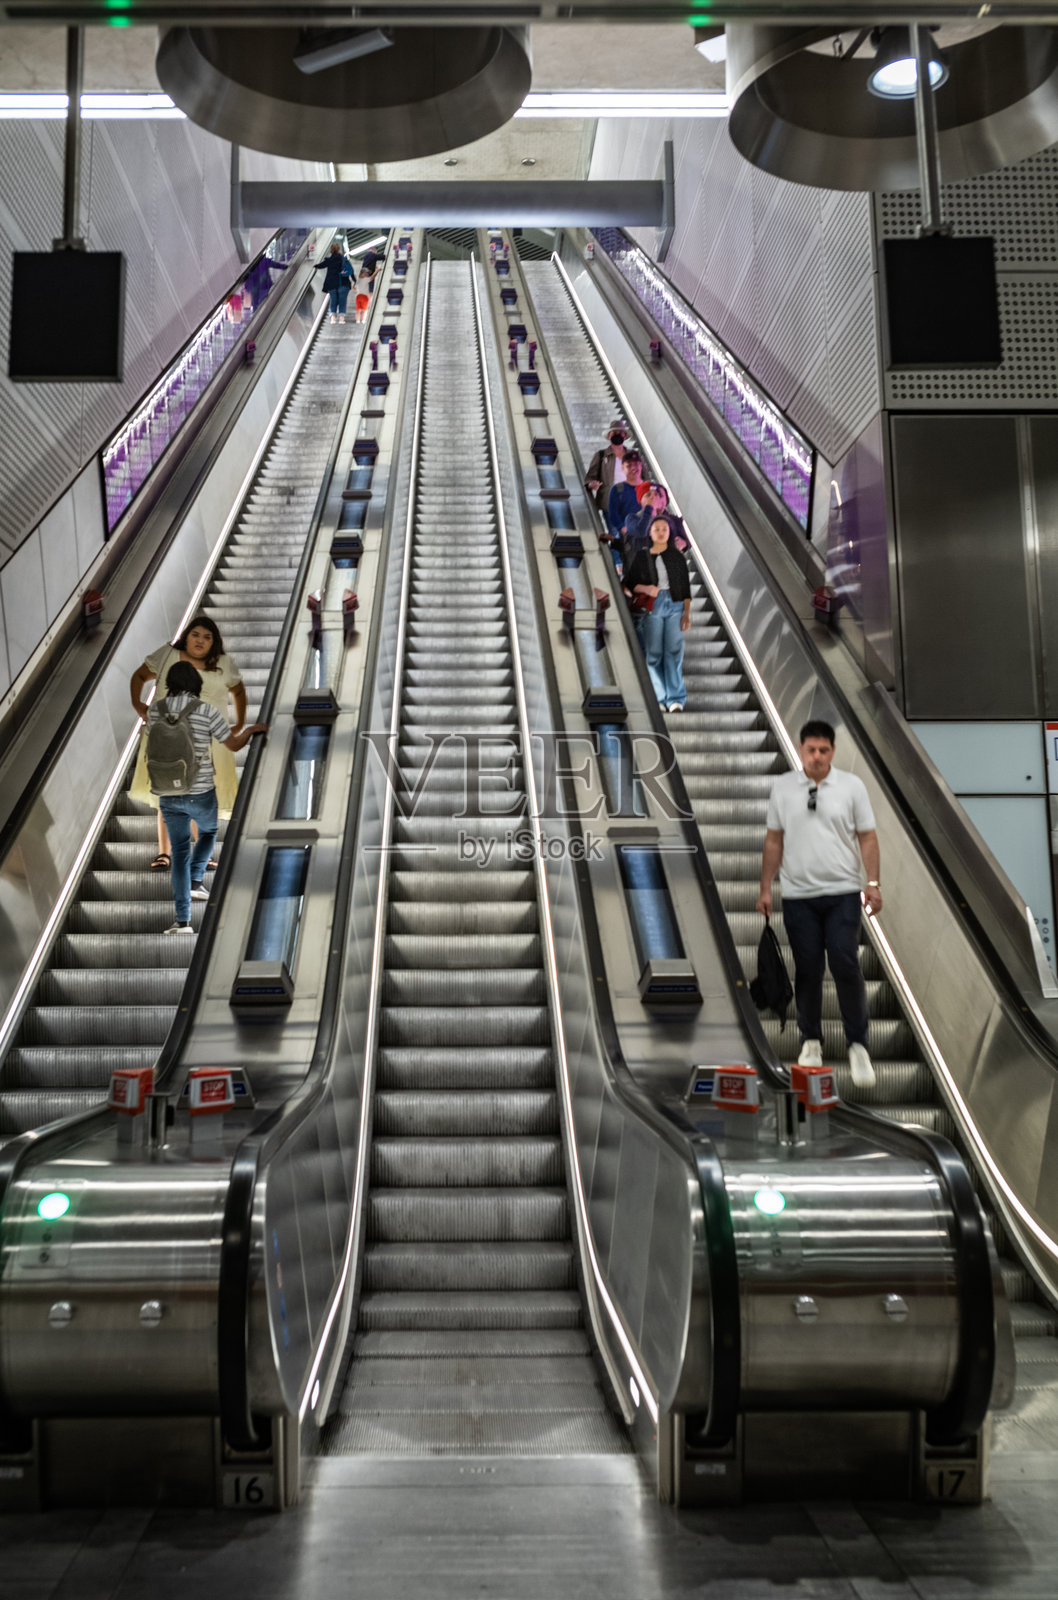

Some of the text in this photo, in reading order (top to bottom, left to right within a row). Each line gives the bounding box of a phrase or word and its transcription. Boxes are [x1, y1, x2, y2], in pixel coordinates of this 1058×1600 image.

[203, 1081, 225, 1092] STOP
[722, 1078, 743, 1088] STOP
[234, 1476, 264, 1504] 16
[938, 1470, 966, 1498] 17
